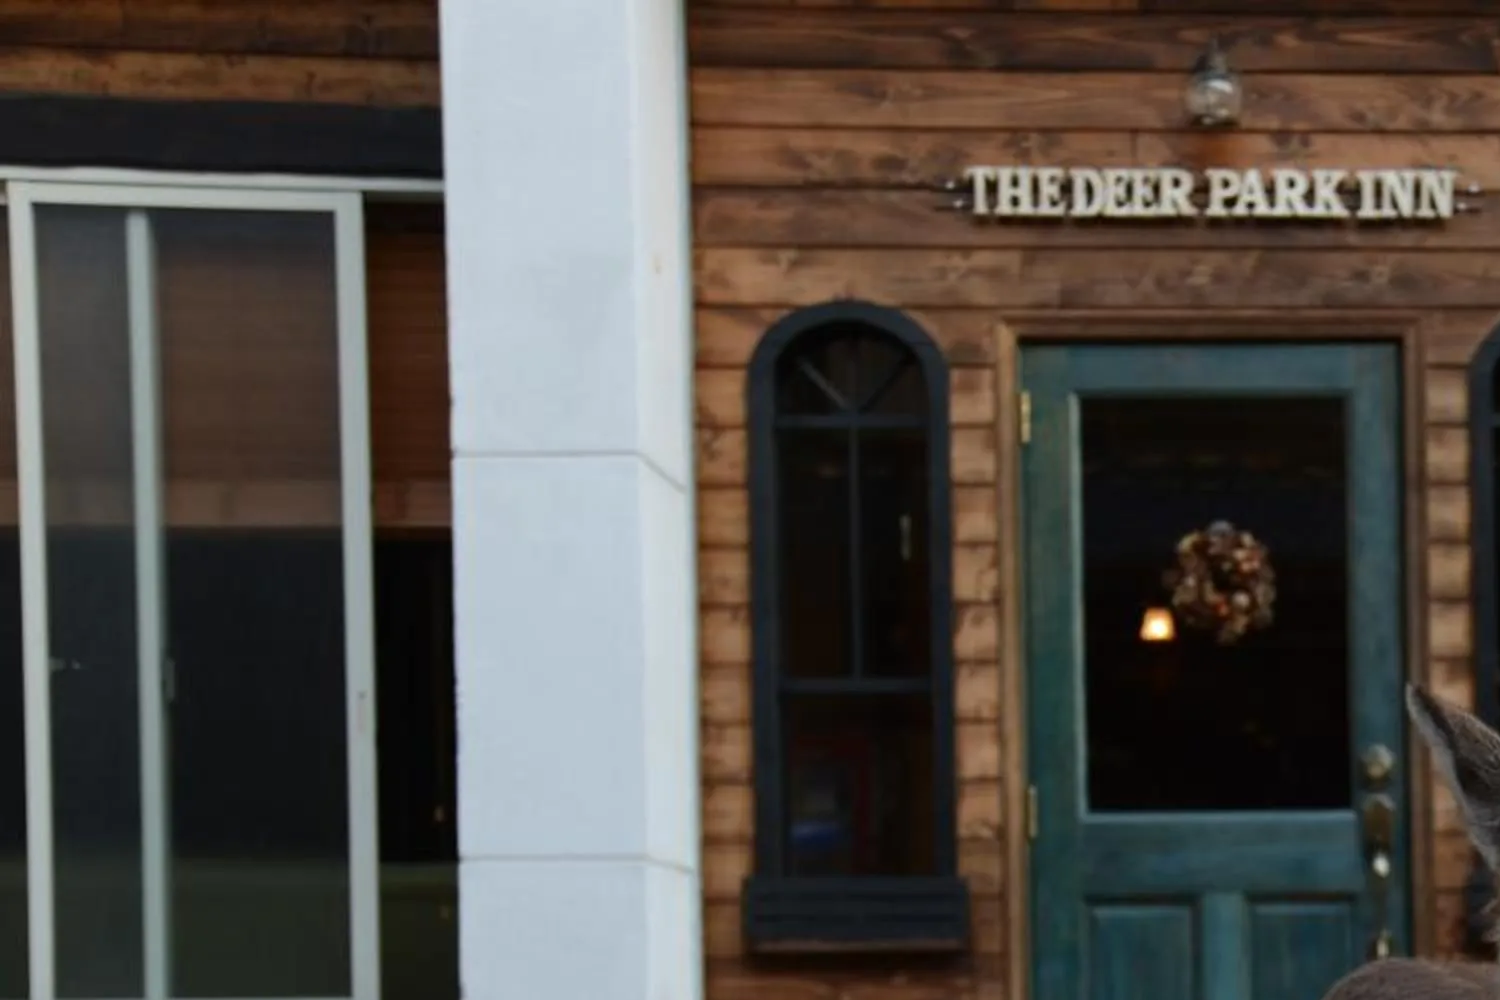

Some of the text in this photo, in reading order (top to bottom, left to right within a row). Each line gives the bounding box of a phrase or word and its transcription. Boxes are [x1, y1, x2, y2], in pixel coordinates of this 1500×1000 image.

[964, 166, 1458, 219] THE DEER PARK INN
